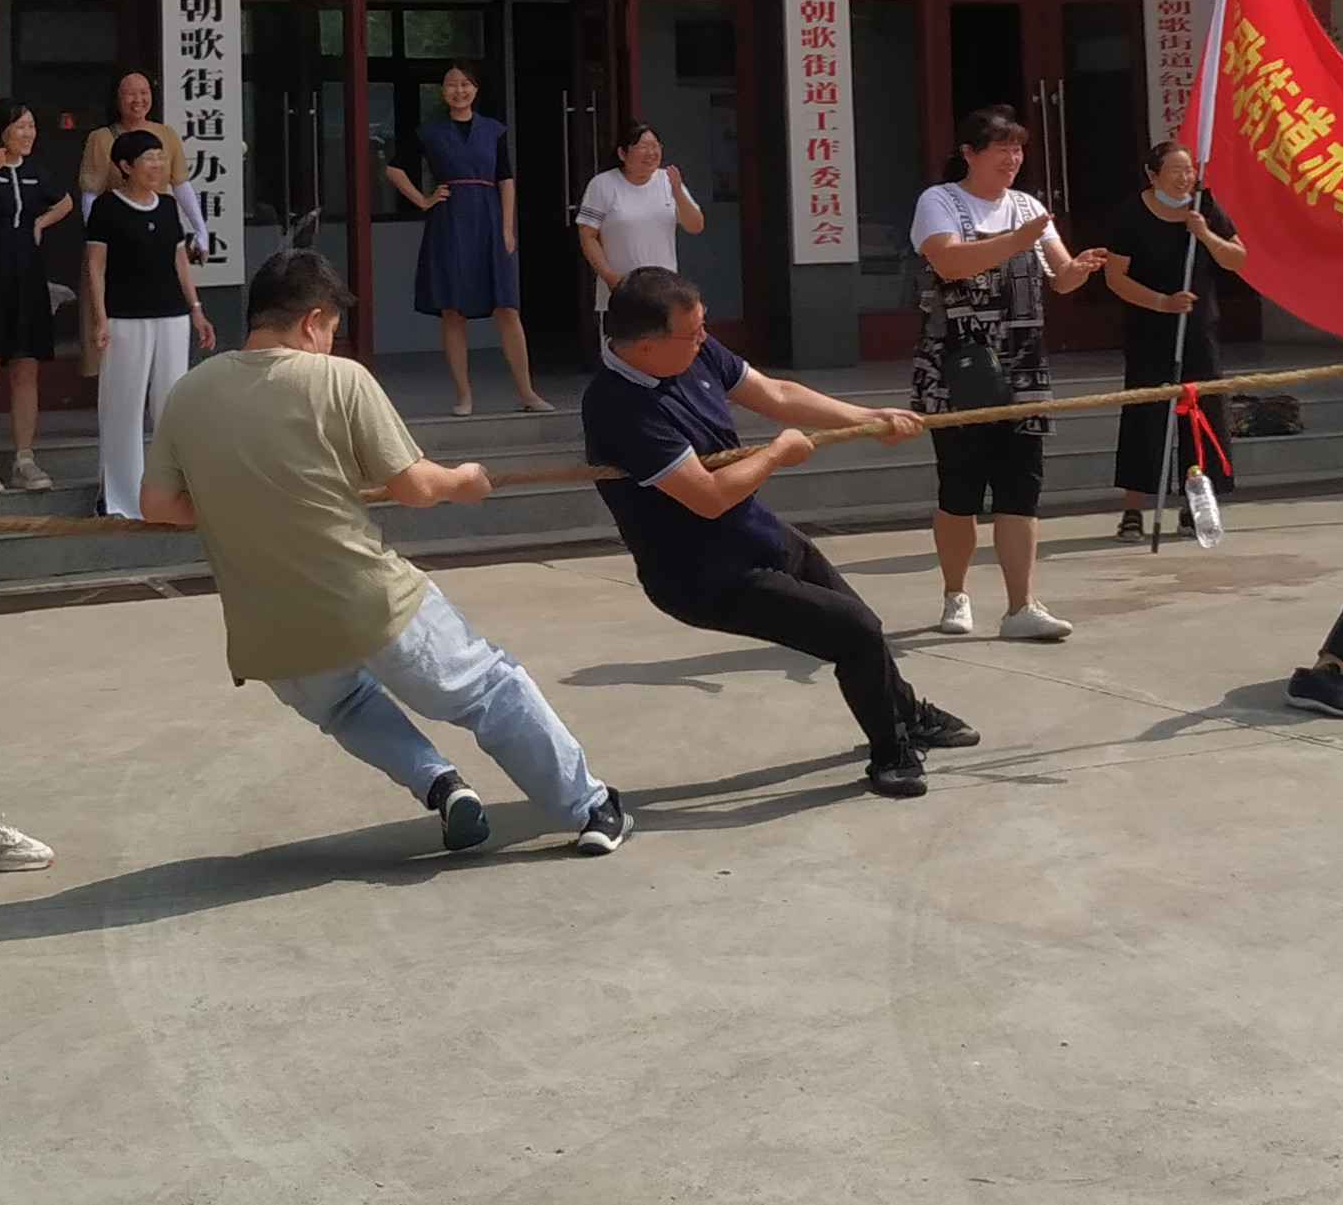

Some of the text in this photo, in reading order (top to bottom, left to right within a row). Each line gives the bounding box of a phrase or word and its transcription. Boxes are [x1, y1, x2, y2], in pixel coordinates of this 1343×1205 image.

[800, 0, 845, 246] 朝歌街道工作委员会
